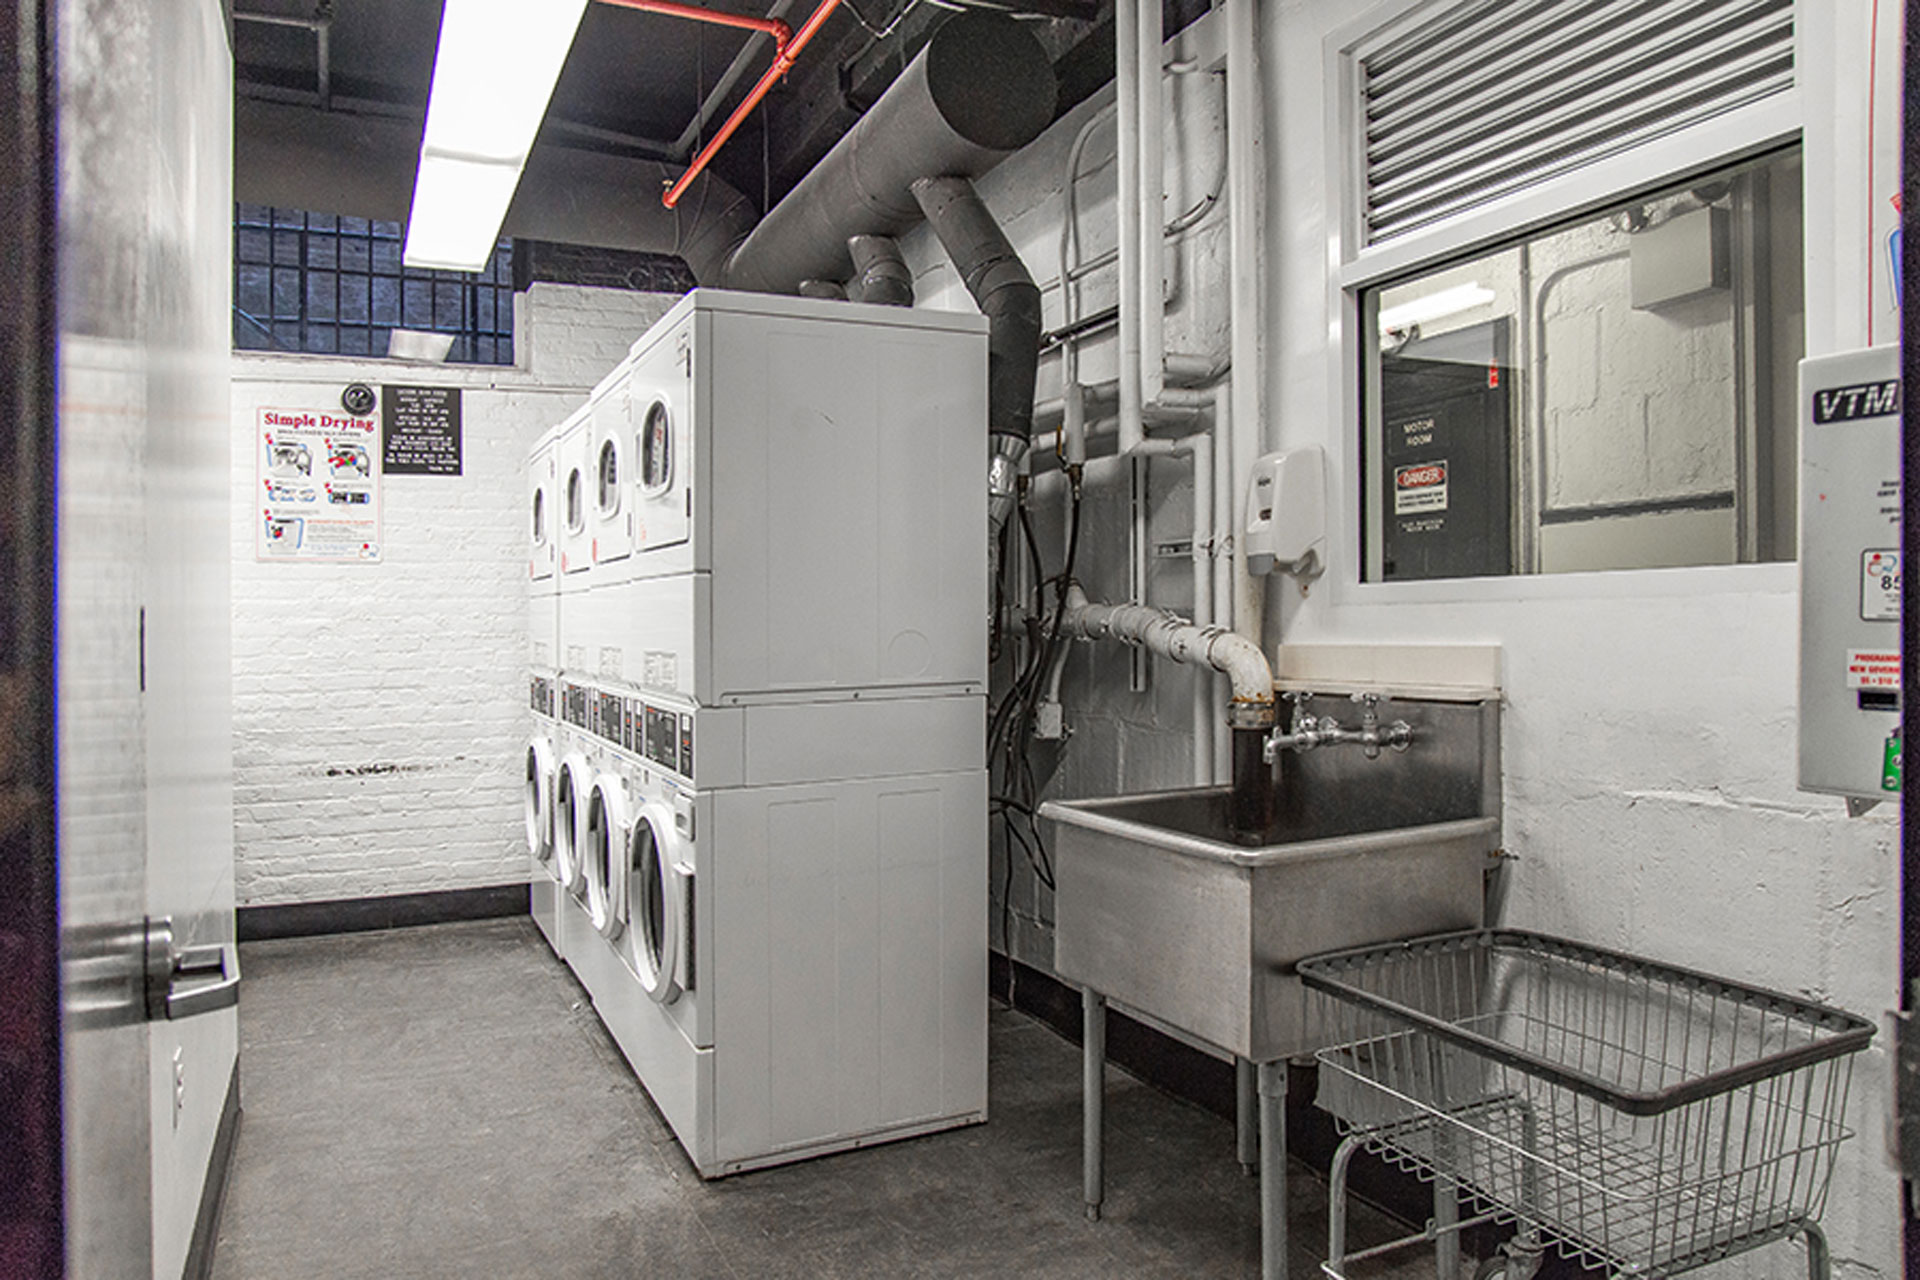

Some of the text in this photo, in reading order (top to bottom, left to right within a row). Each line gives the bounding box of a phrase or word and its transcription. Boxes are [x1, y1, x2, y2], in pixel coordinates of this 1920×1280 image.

[264, 413, 374, 435] Simple Drying
[1403, 419, 1434, 433] MOTOR
[1406, 434, 1432, 446] ROOM
[1403, 468, 1439, 485] DANGER
